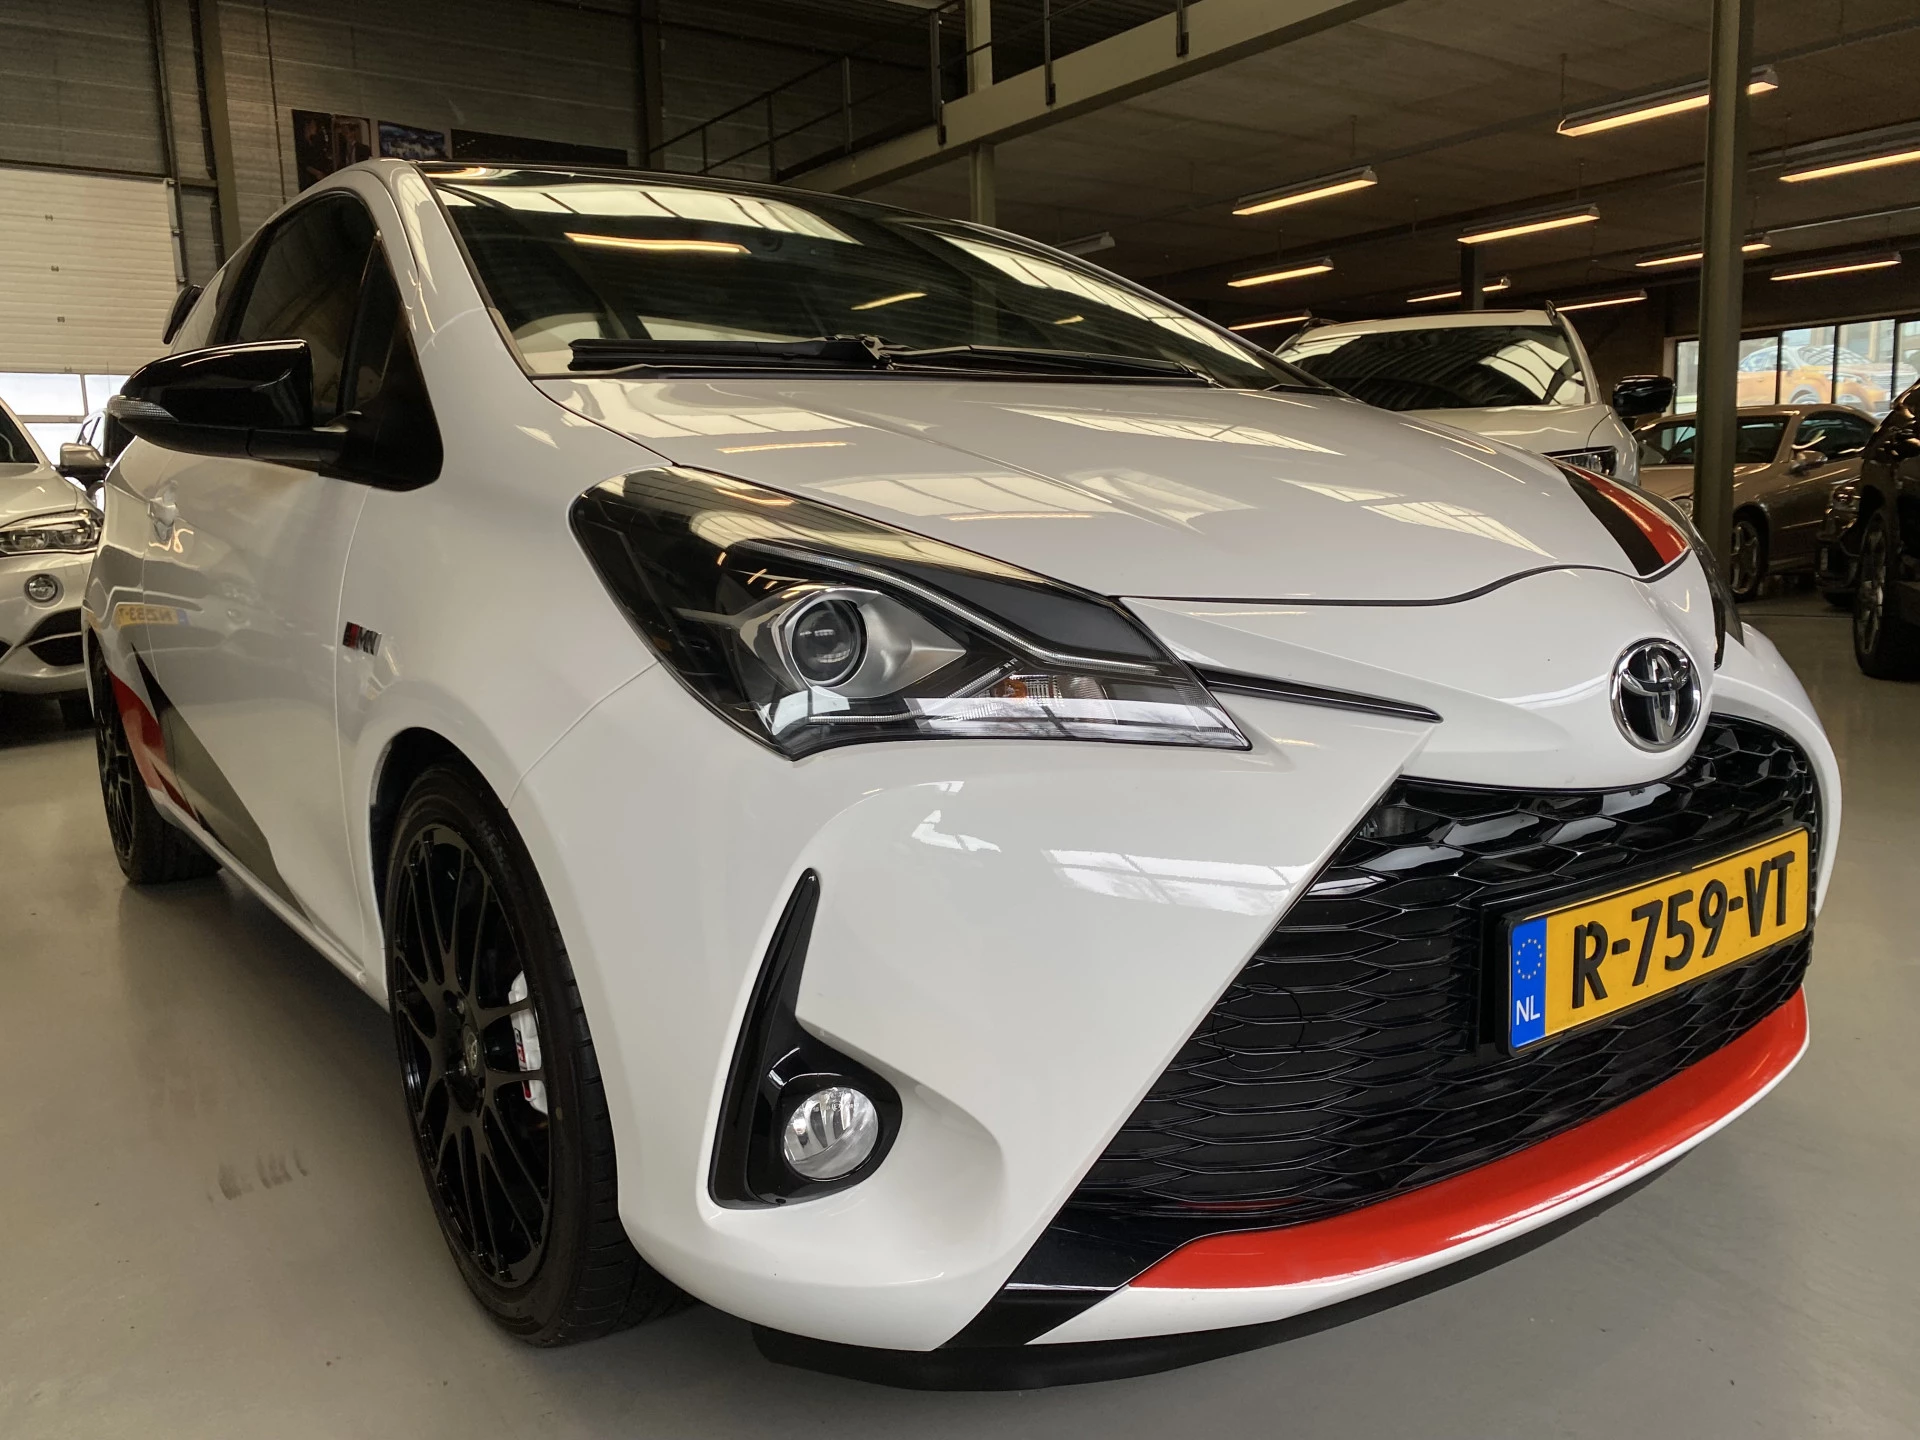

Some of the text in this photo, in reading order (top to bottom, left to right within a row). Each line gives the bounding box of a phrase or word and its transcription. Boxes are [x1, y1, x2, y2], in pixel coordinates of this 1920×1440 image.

[342, 621, 382, 656] MN
[1572, 851, 1795, 1009] R-759-VT
[1516, 995, 1541, 1026] NL
